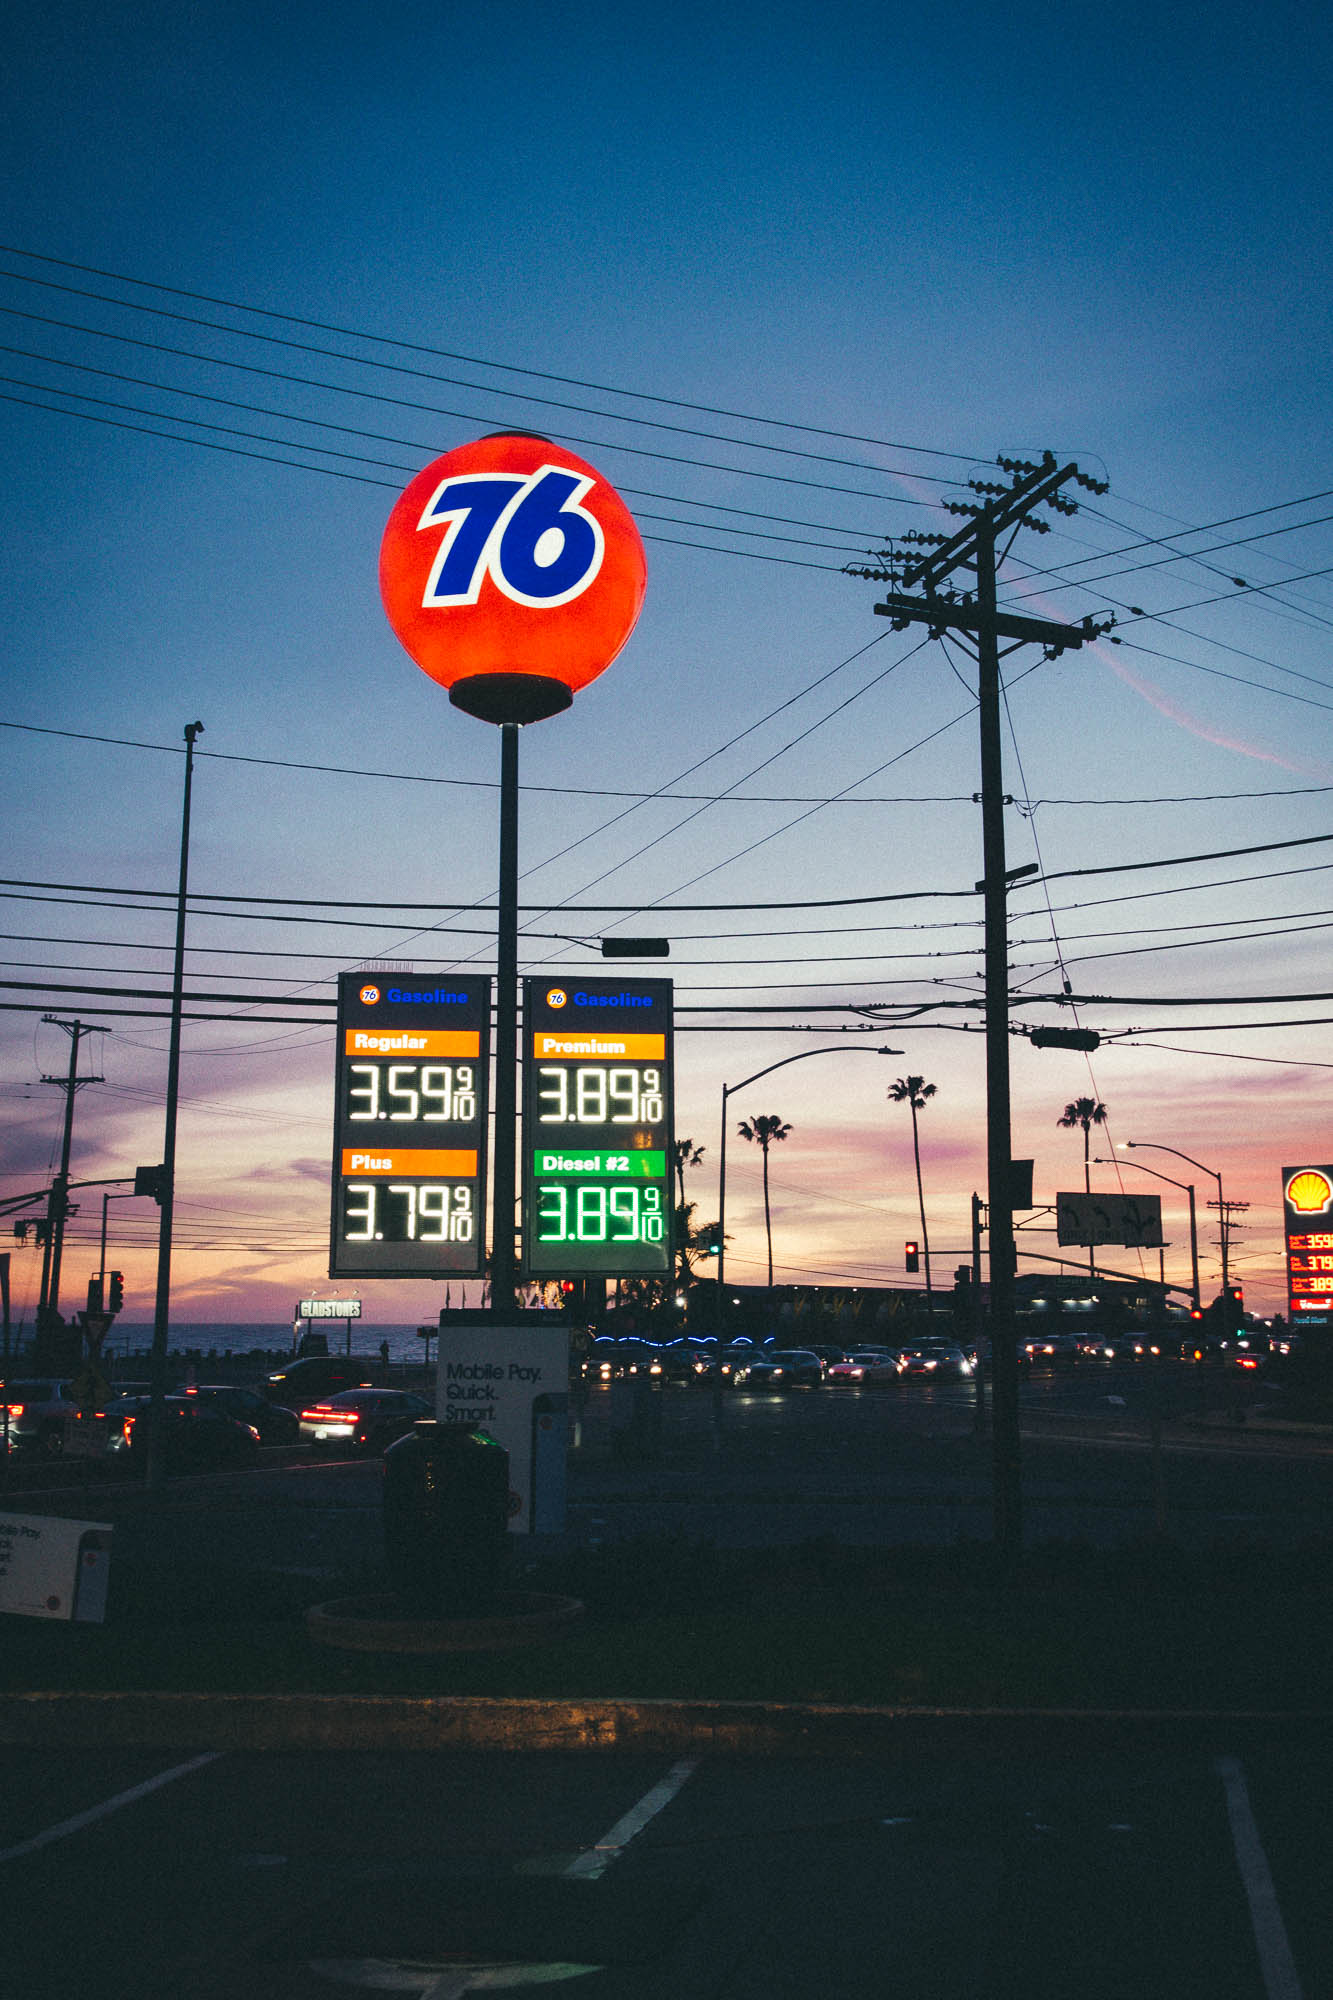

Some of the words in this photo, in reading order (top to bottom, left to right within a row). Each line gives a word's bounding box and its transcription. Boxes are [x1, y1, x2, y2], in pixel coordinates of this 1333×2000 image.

[416, 464, 605, 609] 76
[362, 989, 378, 1003] 76
[387, 988, 469, 1004] Gasoline
[549, 993, 565, 1006] 76
[573, 992, 654, 1007] Gasoline
[354, 1033, 429, 1052] Regular
[543, 1038, 626, 1053] Premium
[349, 1065, 452, 1120] 3.59
[539, 1067, 639, 1122] 3.89
[351, 1154, 392, 1169] Plus
[543, 1156, 600, 1171] Diesel
[605, 1156, 630, 1171] #2
[345, 1184, 450, 1241] 3.79
[539, 1186, 640, 1241] 3.89
[301, 1301, 361, 1317] GLADSTONES
[446, 1363, 504, 1380] Mobile
[508, 1364, 542, 1384] Pay.
[446, 1383, 499, 1400] Quick.
[445, 1404, 497, 1420] Smart.
